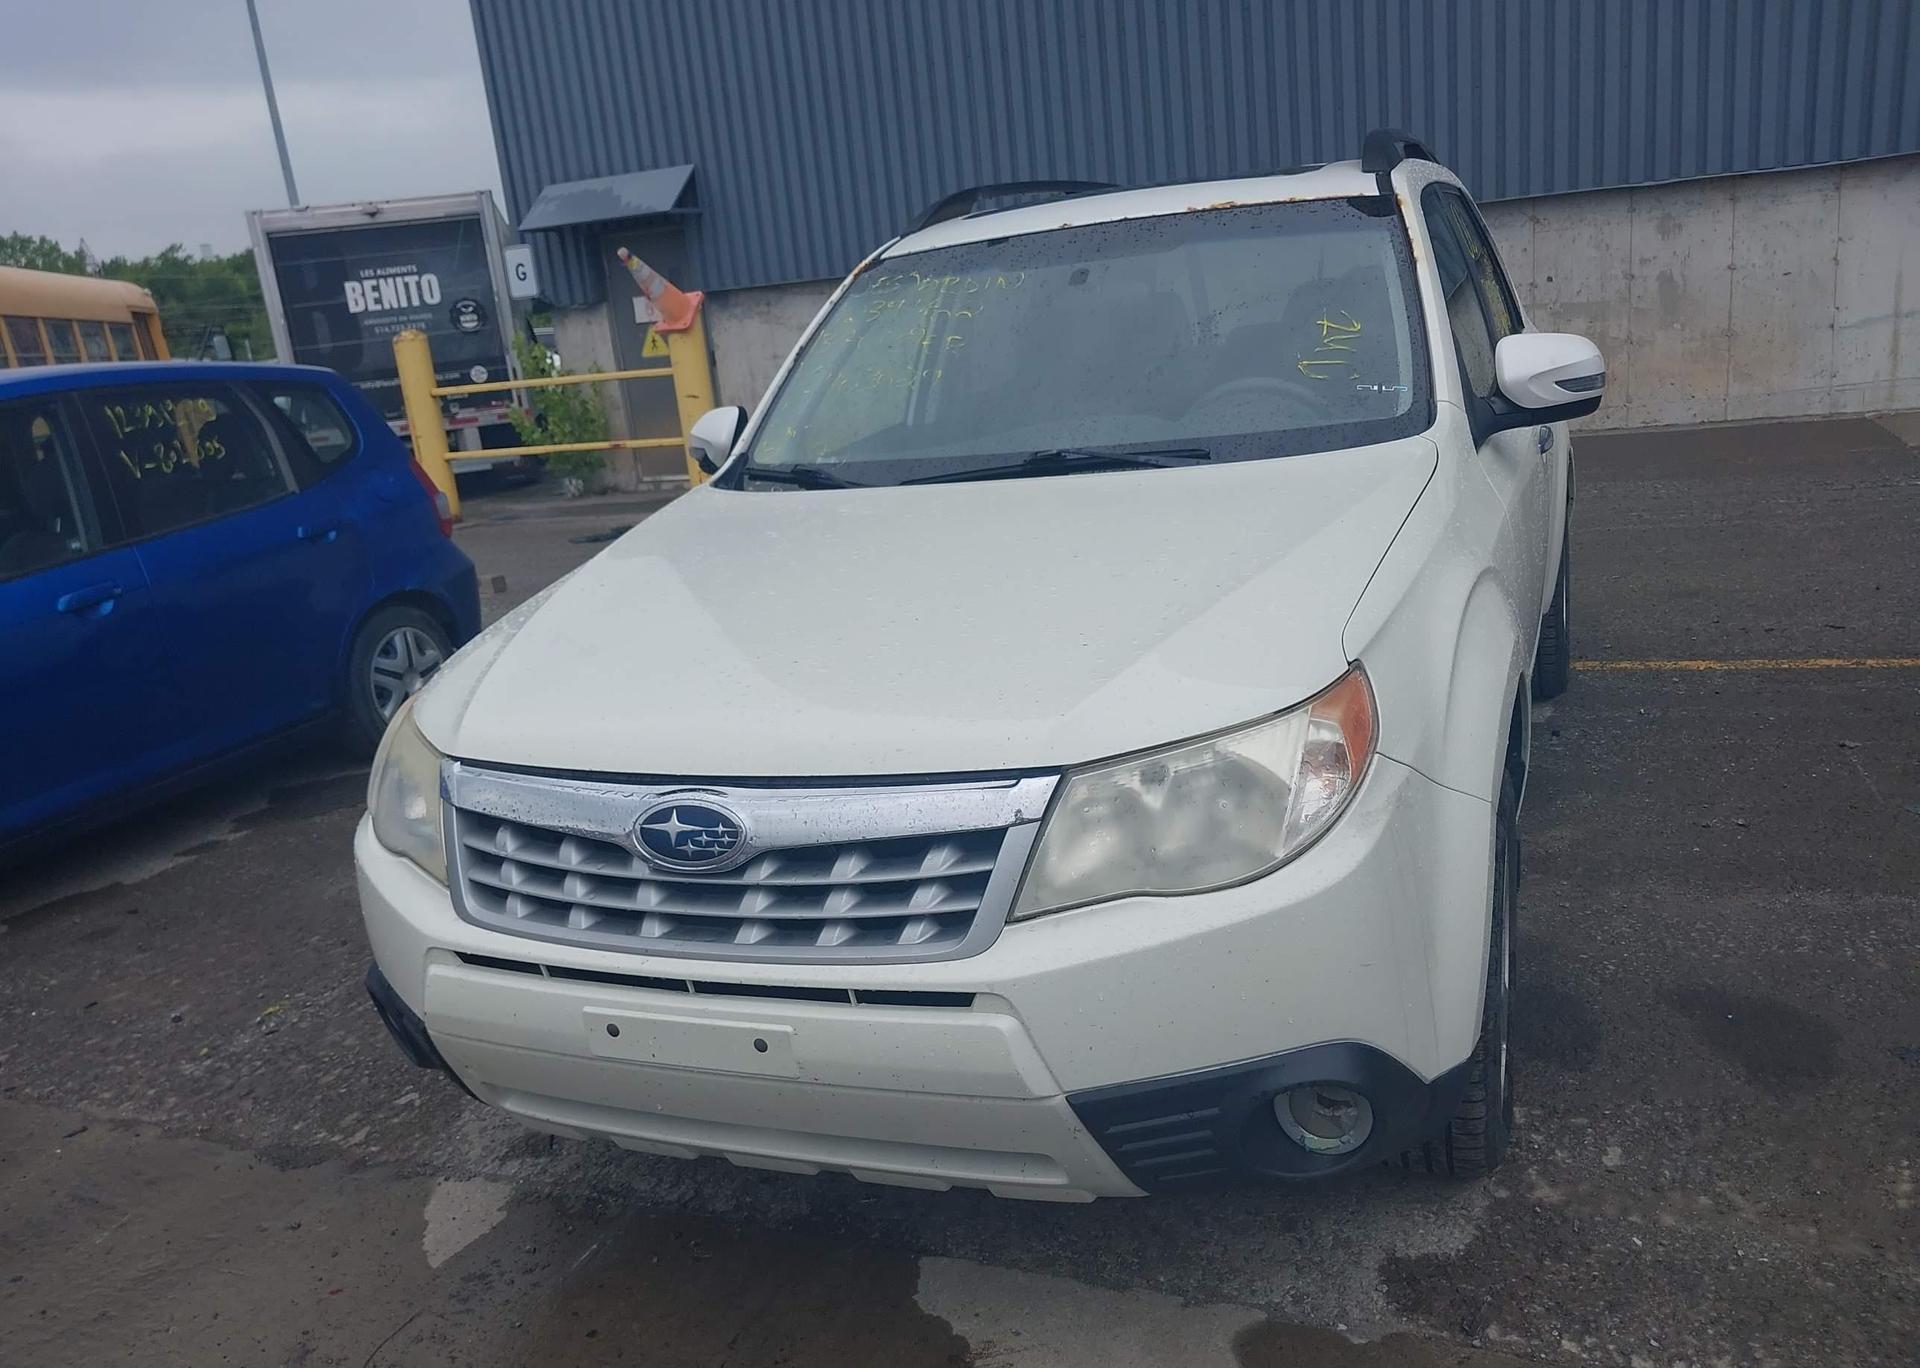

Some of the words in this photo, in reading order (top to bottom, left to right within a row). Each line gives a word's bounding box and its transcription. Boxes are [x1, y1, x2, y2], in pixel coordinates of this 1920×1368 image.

[360, 268, 375, 279] LES
[376, 264, 418, 277] ALIMENTS
[515, 263, 528, 282] G
[344, 272, 442, 314] BENITO
